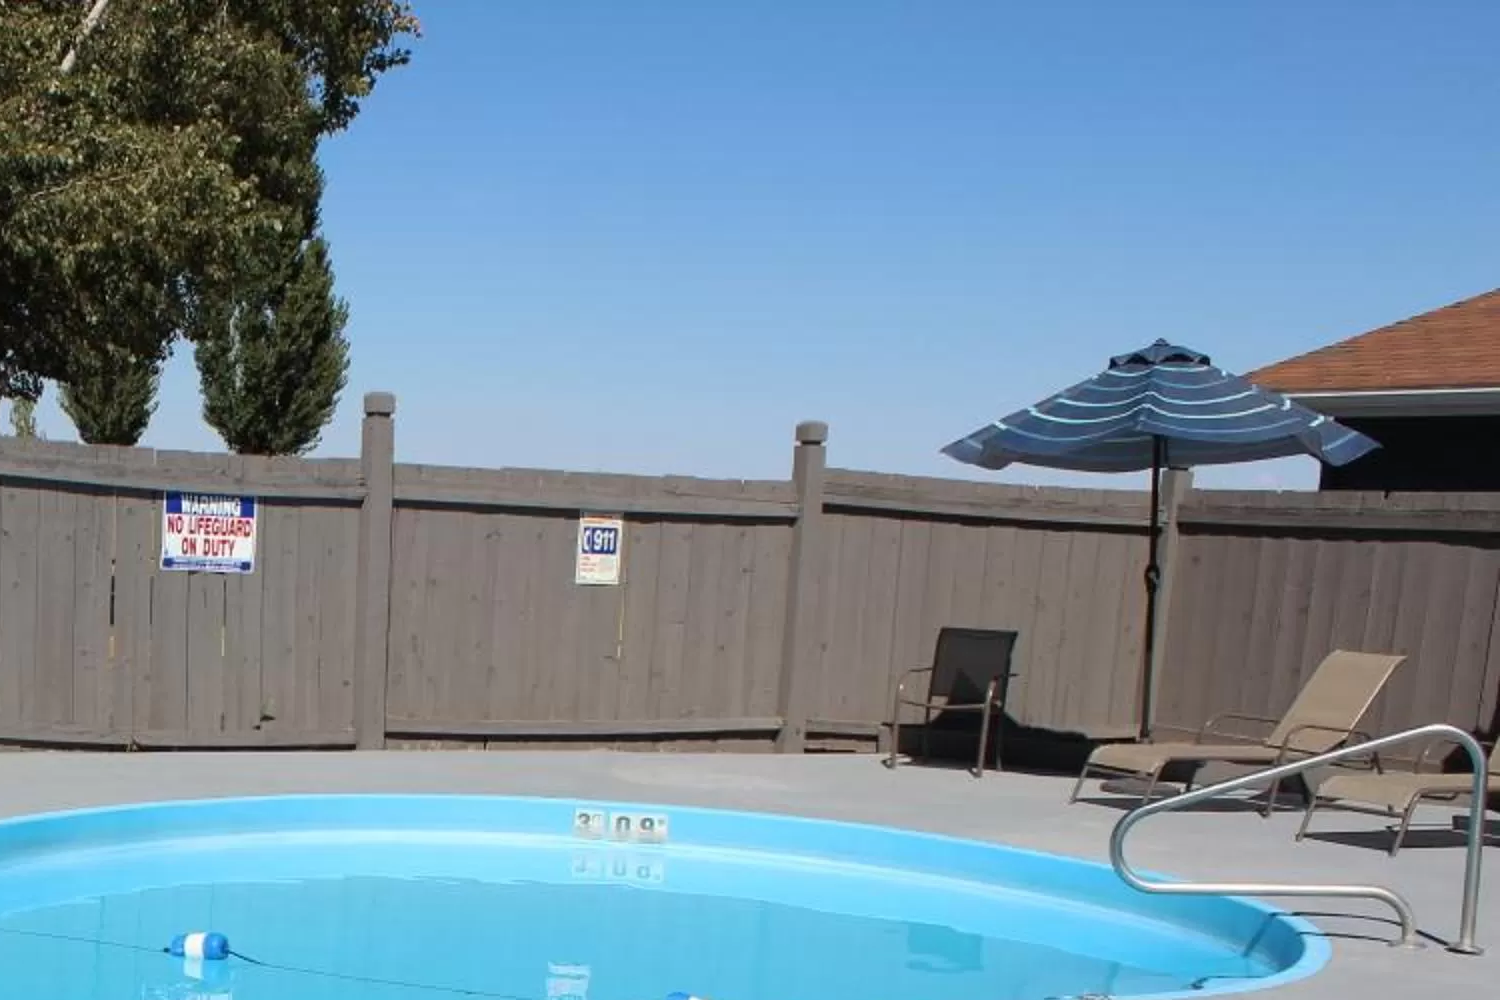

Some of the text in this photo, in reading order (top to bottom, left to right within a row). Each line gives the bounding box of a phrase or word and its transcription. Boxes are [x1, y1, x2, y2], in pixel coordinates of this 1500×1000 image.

[182, 494, 241, 516] WARNING
[167, 516, 251, 537] NO LIFEGUARD
[182, 538, 235, 556] ON DUTY
[594, 529, 615, 552] 911
